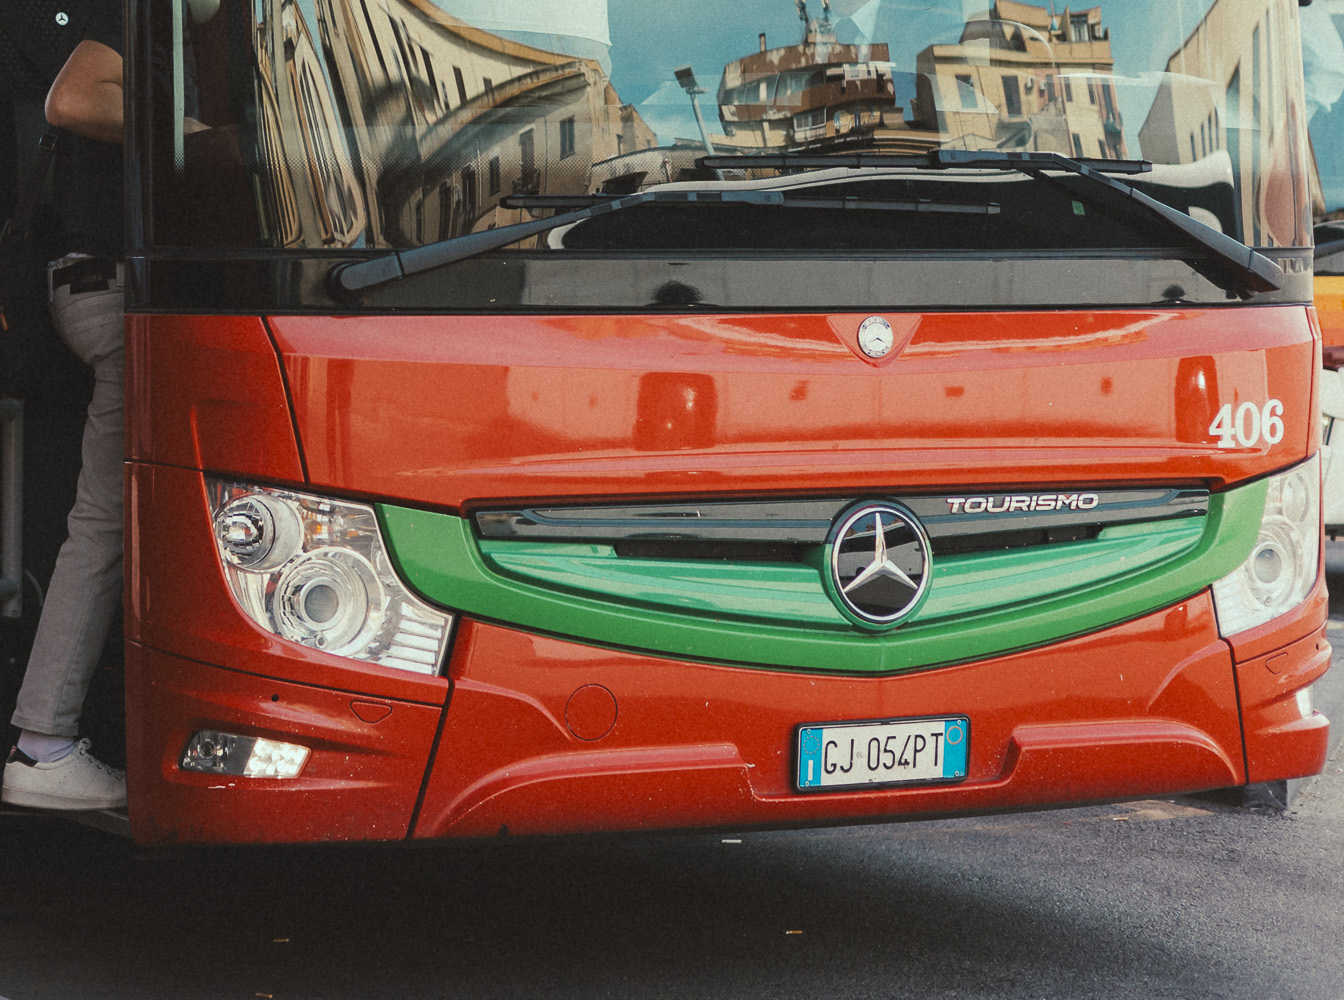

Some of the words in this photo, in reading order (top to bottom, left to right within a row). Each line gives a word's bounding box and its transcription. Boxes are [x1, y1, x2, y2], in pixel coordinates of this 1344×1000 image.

[1208, 399, 1285, 449] 406
[946, 493, 1099, 514] TOURISMO
[823, 738, 855, 775] GJ
[867, 732, 944, 772] 054PT
